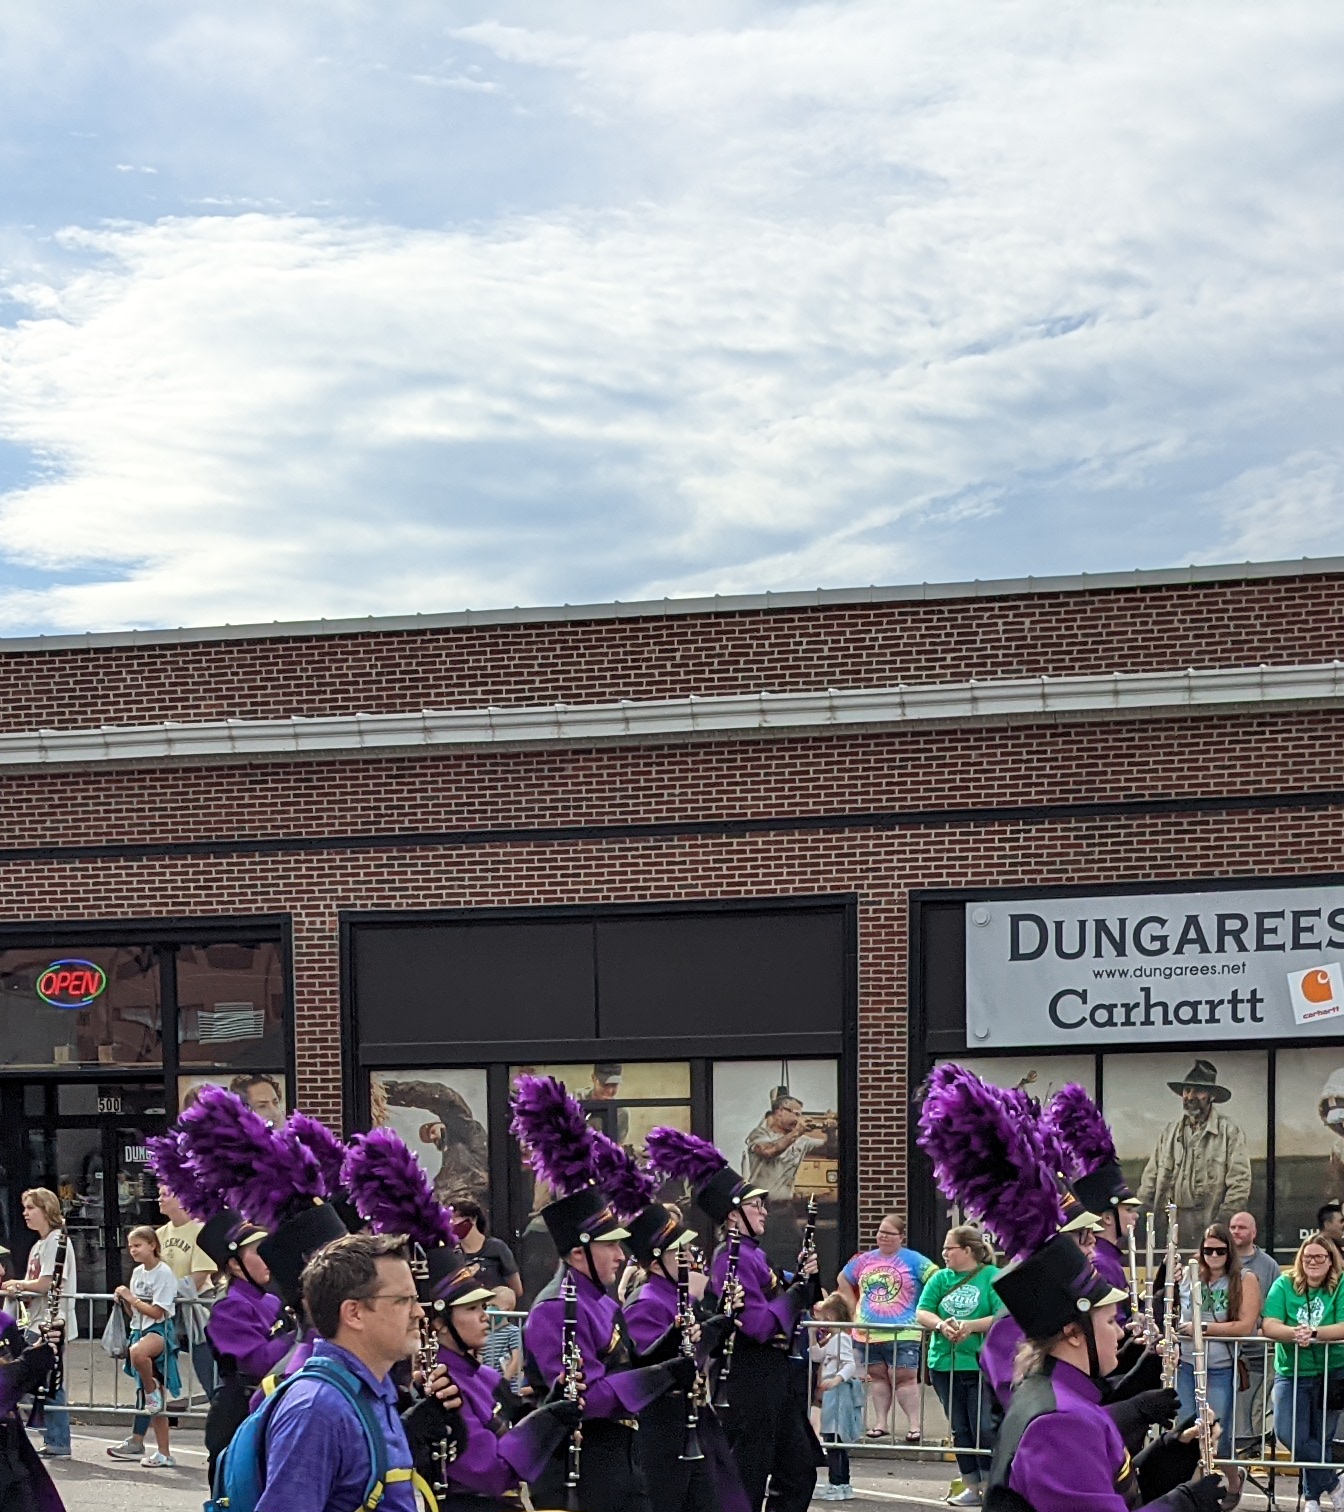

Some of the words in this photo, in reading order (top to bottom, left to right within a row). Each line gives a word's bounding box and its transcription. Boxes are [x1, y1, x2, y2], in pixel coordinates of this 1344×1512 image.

[1092, 961, 1247, 980] www.dungarees.net
[40, 971, 100, 995] OPEN
[1048, 987, 1264, 1029] Carhartt
[1302, 1006, 1340, 1020] carhartt
[98, 1099, 120, 1112] 500
